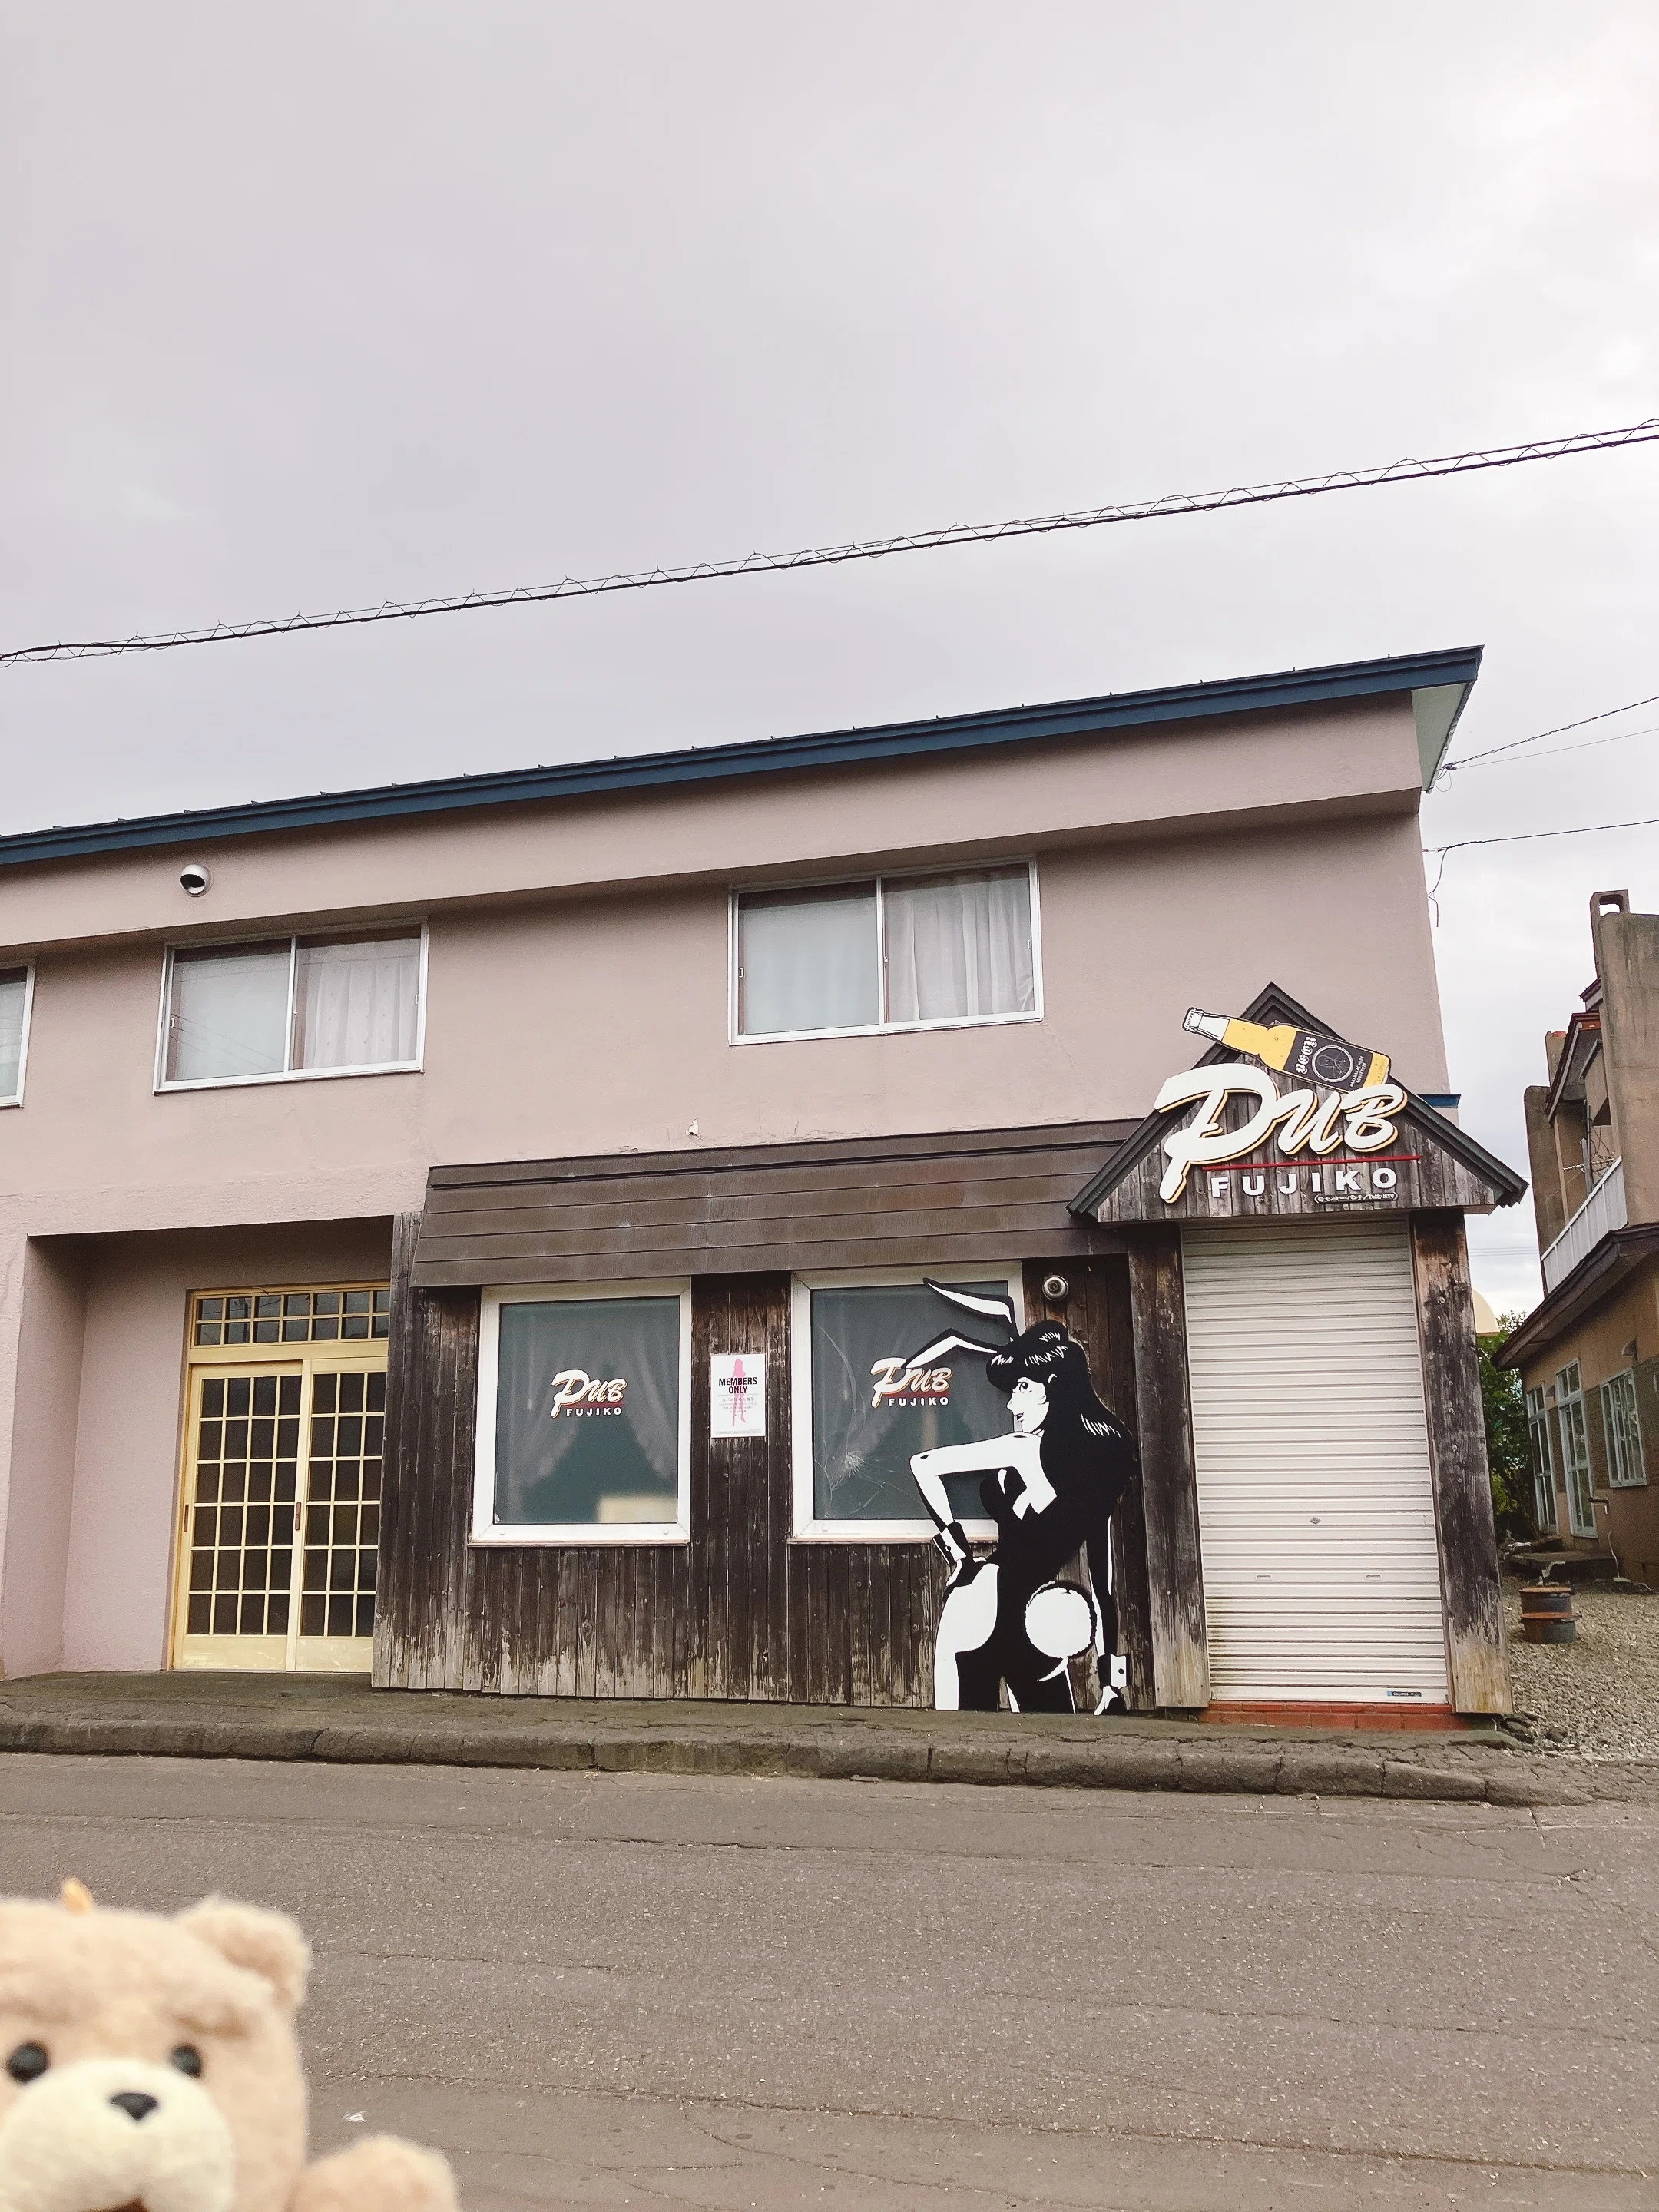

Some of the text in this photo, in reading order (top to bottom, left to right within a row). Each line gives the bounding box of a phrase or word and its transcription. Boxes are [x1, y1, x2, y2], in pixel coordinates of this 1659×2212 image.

[1153, 1062, 1408, 1204] PUB
[1210, 1167, 1398, 1198] FUJIKO
[718, 1376, 758, 1386] MEMBERS
[551, 1369, 628, 1419] PUB
[728, 1386, 748, 1394] ONLY
[887, 1396, 949, 1407] FUJIKO
[566, 1407, 623, 1417] FUJIKO
